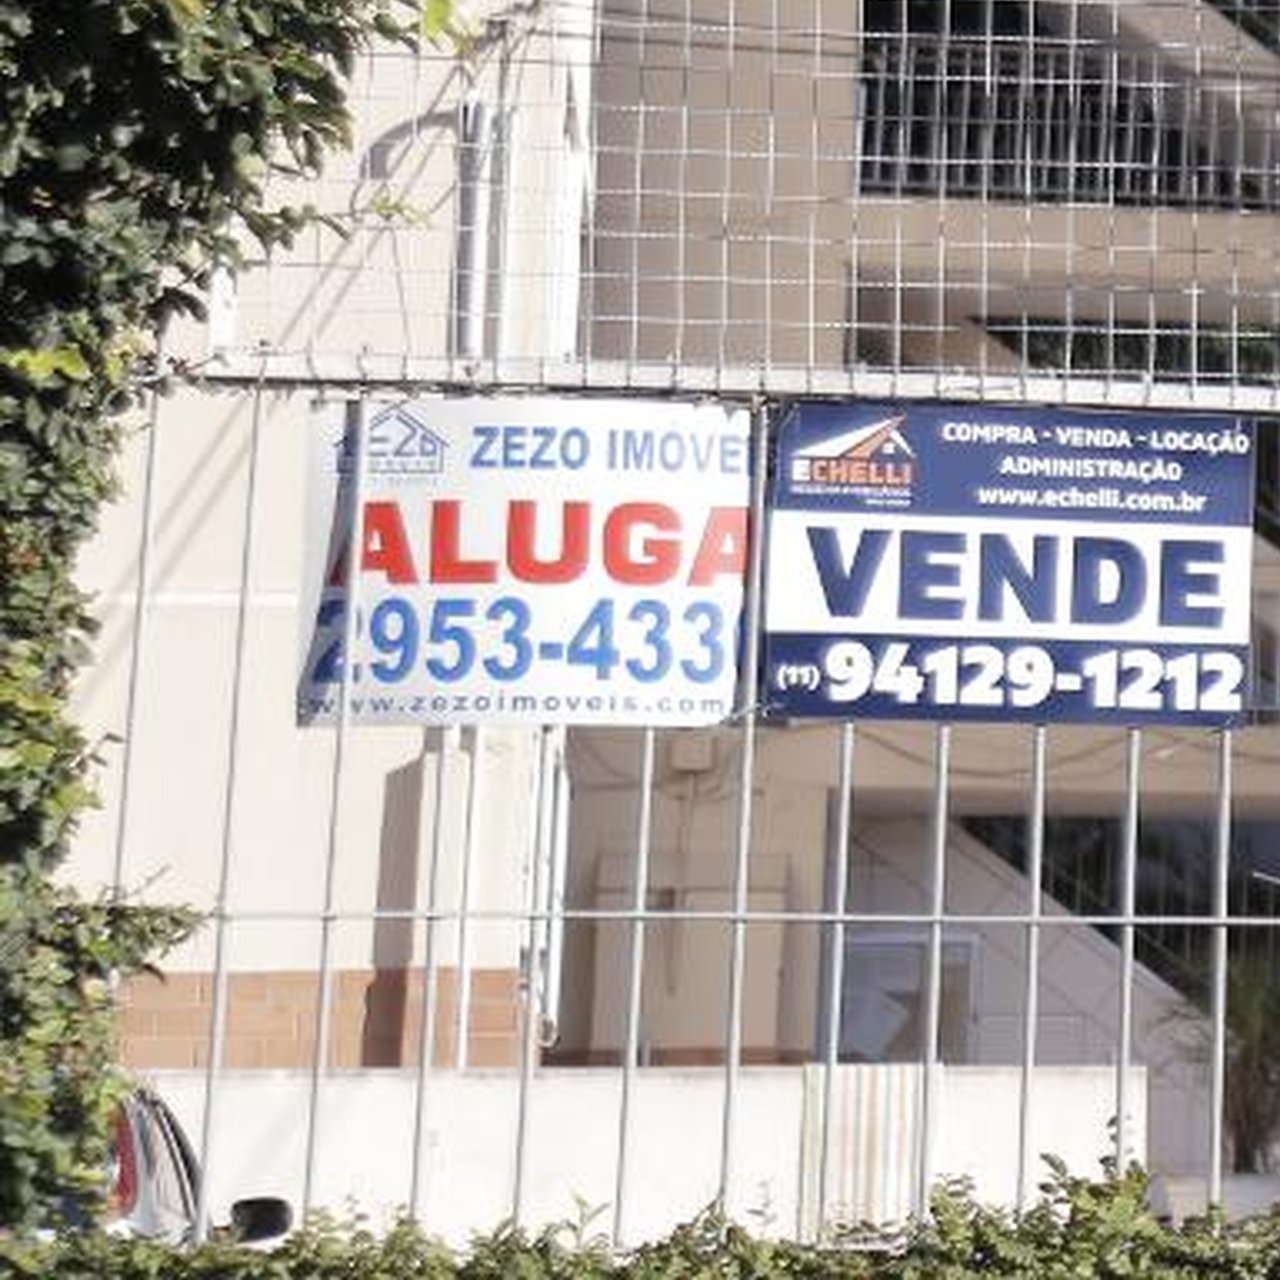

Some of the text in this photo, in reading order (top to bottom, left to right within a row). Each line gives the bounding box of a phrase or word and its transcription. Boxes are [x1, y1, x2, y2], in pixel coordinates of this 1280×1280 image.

[469, 426, 591, 470] ZEZO
[942, 422, 1037, 445] COMPRA
[1055, 426, 1132, 449] VENDA
[1151, 429, 1250, 456] LOCAÇÃO
[791, 458, 912, 484] ECHELLI
[1000, 455, 1184, 483] ADMINISTRAÇÃO
[977, 486, 1208, 512] www.echelli.com.br
[330, 500, 750, 587] ALUGA
[806, 526, 1226, 629] VENDE
[313, 596, 746, 685] 2953-433
[777, 641, 1245, 711] (11) 94129-1212
